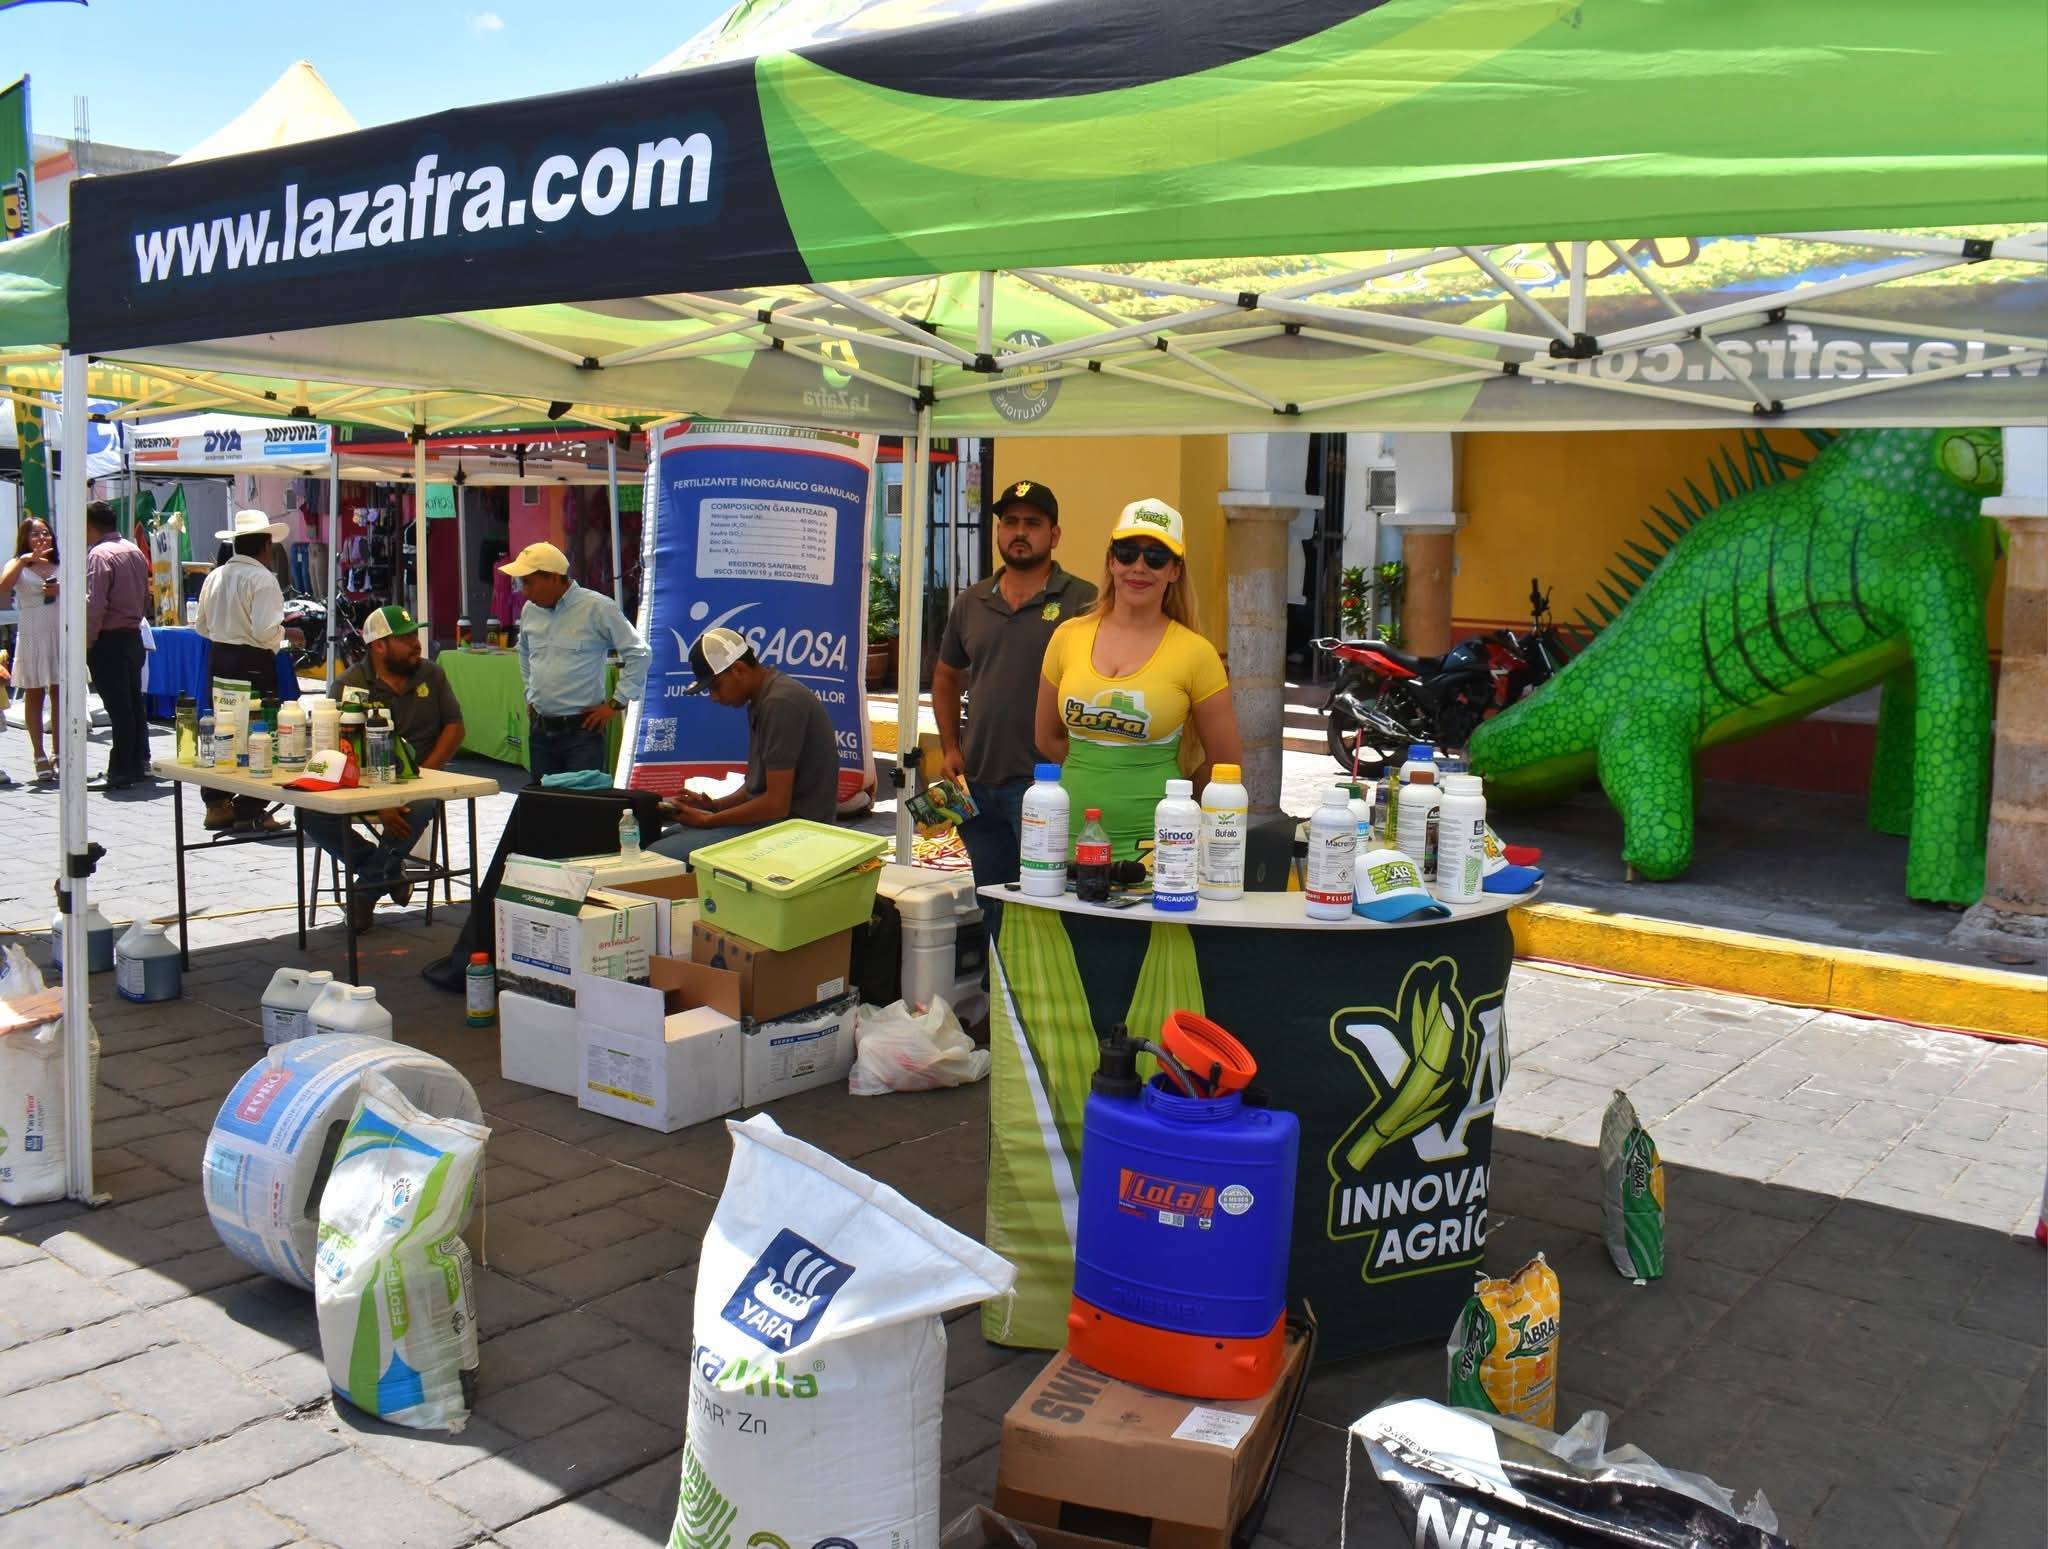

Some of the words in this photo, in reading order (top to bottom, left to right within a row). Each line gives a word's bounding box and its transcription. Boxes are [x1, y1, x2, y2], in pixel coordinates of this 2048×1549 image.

[134, 131, 713, 284] www.lazafra.com
[204, 429, 242, 452] DVA
[264, 425, 318, 443] ADYUVIA
[673, 477, 738, 490] FERTILIZANTE
[740, 477, 809, 493] INORGÁNICO
[810, 484, 860, 504] GRANULADO
[710, 502, 771, 513] COMPOSICIÓN
[1067, 700, 1082, 712] La
[1067, 710, 1143, 734] Zafra
[835, 729, 857, 748] KG
[1158, 828, 1193, 840] Siroco
[242, 1072, 286, 1117] TORO
[739, 1296, 794, 1348] YARA
[737, 1411, 768, 1435] Zn
